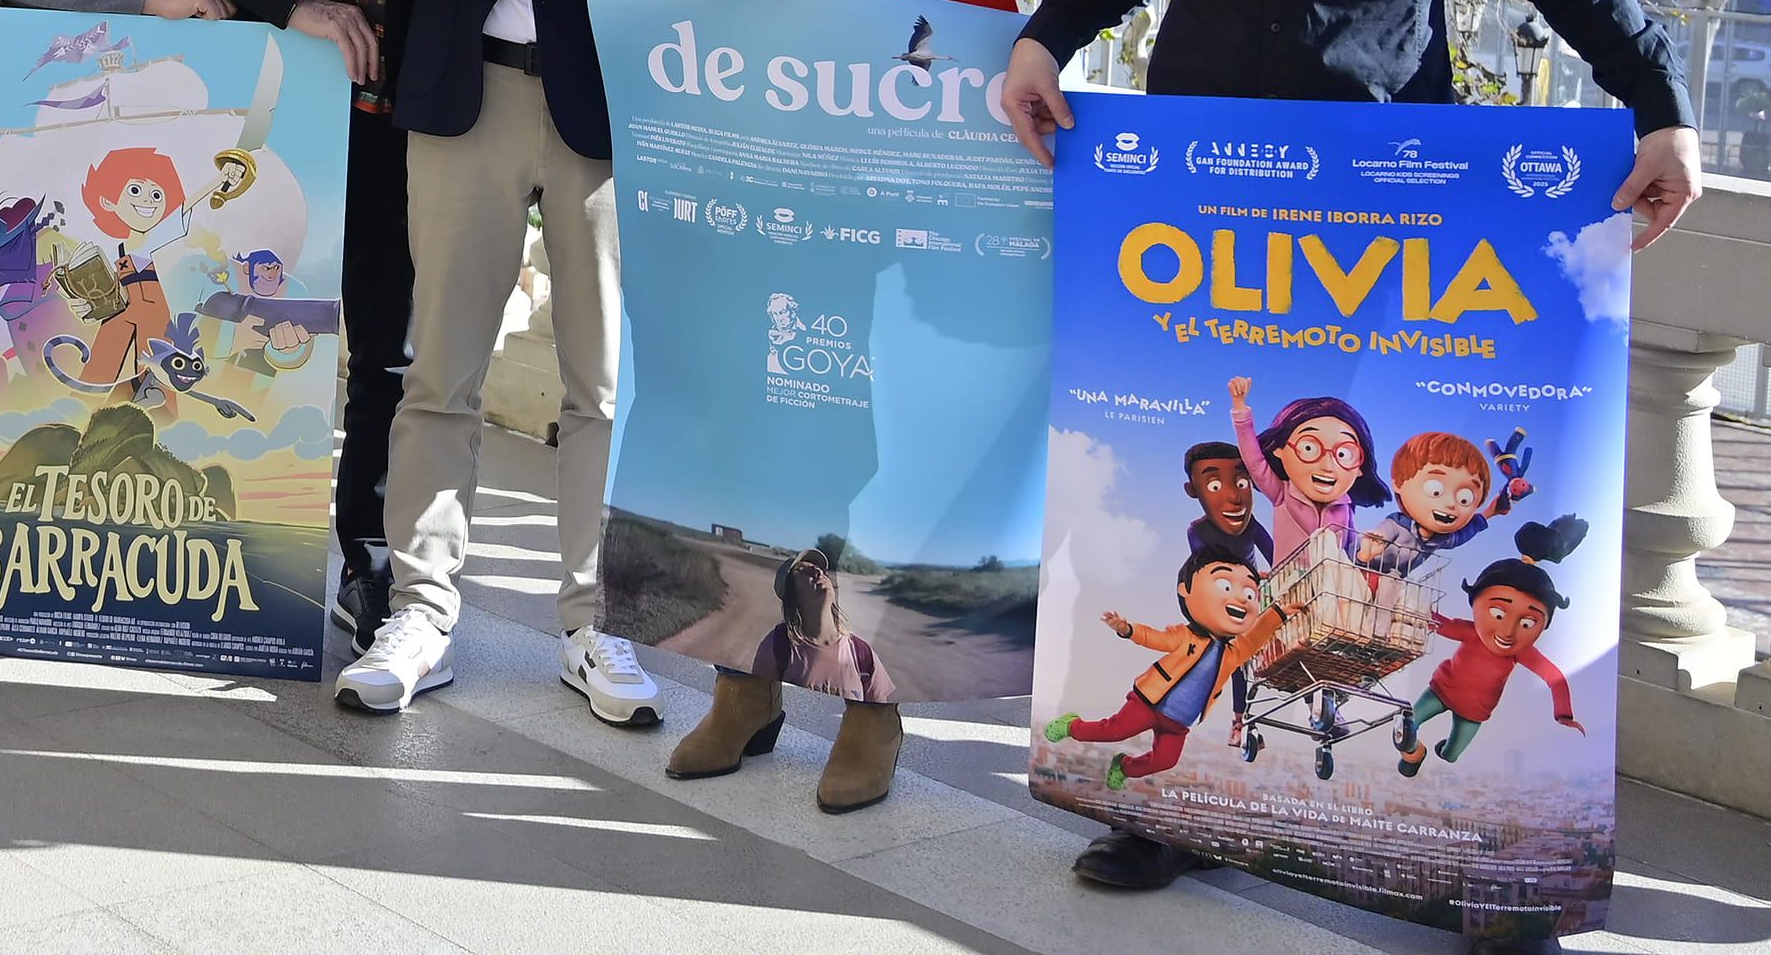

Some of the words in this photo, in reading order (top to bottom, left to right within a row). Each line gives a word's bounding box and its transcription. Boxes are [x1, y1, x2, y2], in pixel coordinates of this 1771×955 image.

[647, 20, 745, 102] de
[868, 127, 886, 136] una
[931, 129, 944, 139] de
[948, 129, 998, 142] CLÀUDIA
[1105, 151, 1147, 165] SEMINCI
[1402, 149, 1417, 158] 78
[1196, 156, 1214, 165] GAN
[1216, 157, 1273, 169] FOUNDATION
[1275, 161, 1309, 171] AWARD
[1352, 158, 1396, 169] Locarno
[1399, 160, 1422, 169] Film
[1424, 160, 1469, 170] Festival
[1519, 162, 1562, 174] OTTAWA
[1209, 167, 1226, 175] FOR
[1229, 168, 1293, 178] DISTRIBUTION
[1198, 204, 1217, 215] UN
[1220, 206, 1248, 217] FILM
[1251, 208, 1268, 218] DE
[1273, 208, 1322, 222] IRENE
[1327, 211, 1395, 224] IBORRA
[1400, 212, 1443, 226] RIZO
[765, 222, 802, 234] SEMINCI
[839, 227, 881, 244] FICG
[1117, 221, 1538, 326] OLIVIA
[810, 314, 848, 337] 40
[806, 336, 852, 350] PREMIOS
[1153, 312, 1172, 332] Y
[1175, 317, 1200, 343] EL
[1204, 318, 1362, 354] TERREMOTO
[1369, 328, 1496, 359] INVISIBLE
[783, 345, 875, 382] GOYA
[766, 376, 830, 393] NOMINADO
[766, 386, 796, 397] MEJOR
[797, 391, 869, 409] CORTOMETRAJE
[766, 394, 778, 403] DE
[780, 395, 815, 409] FICCIÓN
[1479, 402, 1530, 412] VARIETY
[1104, 410, 1116, 420] LE
[1118, 411, 1165, 425] PARISIEN
[4, 482, 38, 514] EL
[34, 465, 185, 530] TESORO
[188, 496, 217, 522] DE
[1262, 792, 1307, 807] BASADA
[1309, 799, 1324, 809] EN
[1328, 802, 1339, 813] EL
[1342, 804, 1373, 816] LIBRO
[1161, 788, 1178, 800] LA
[1182, 790, 1246, 810] PELÍCULA
[1250, 800, 1268, 813] DE
[1271, 803, 1288, 816] LA
[1293, 806, 1328, 822] VIDA
[1331, 814, 1348, 824] DE
[1348, 814, 1393, 832] MAITE
[1396, 822, 1483, 843] CARRANZA
